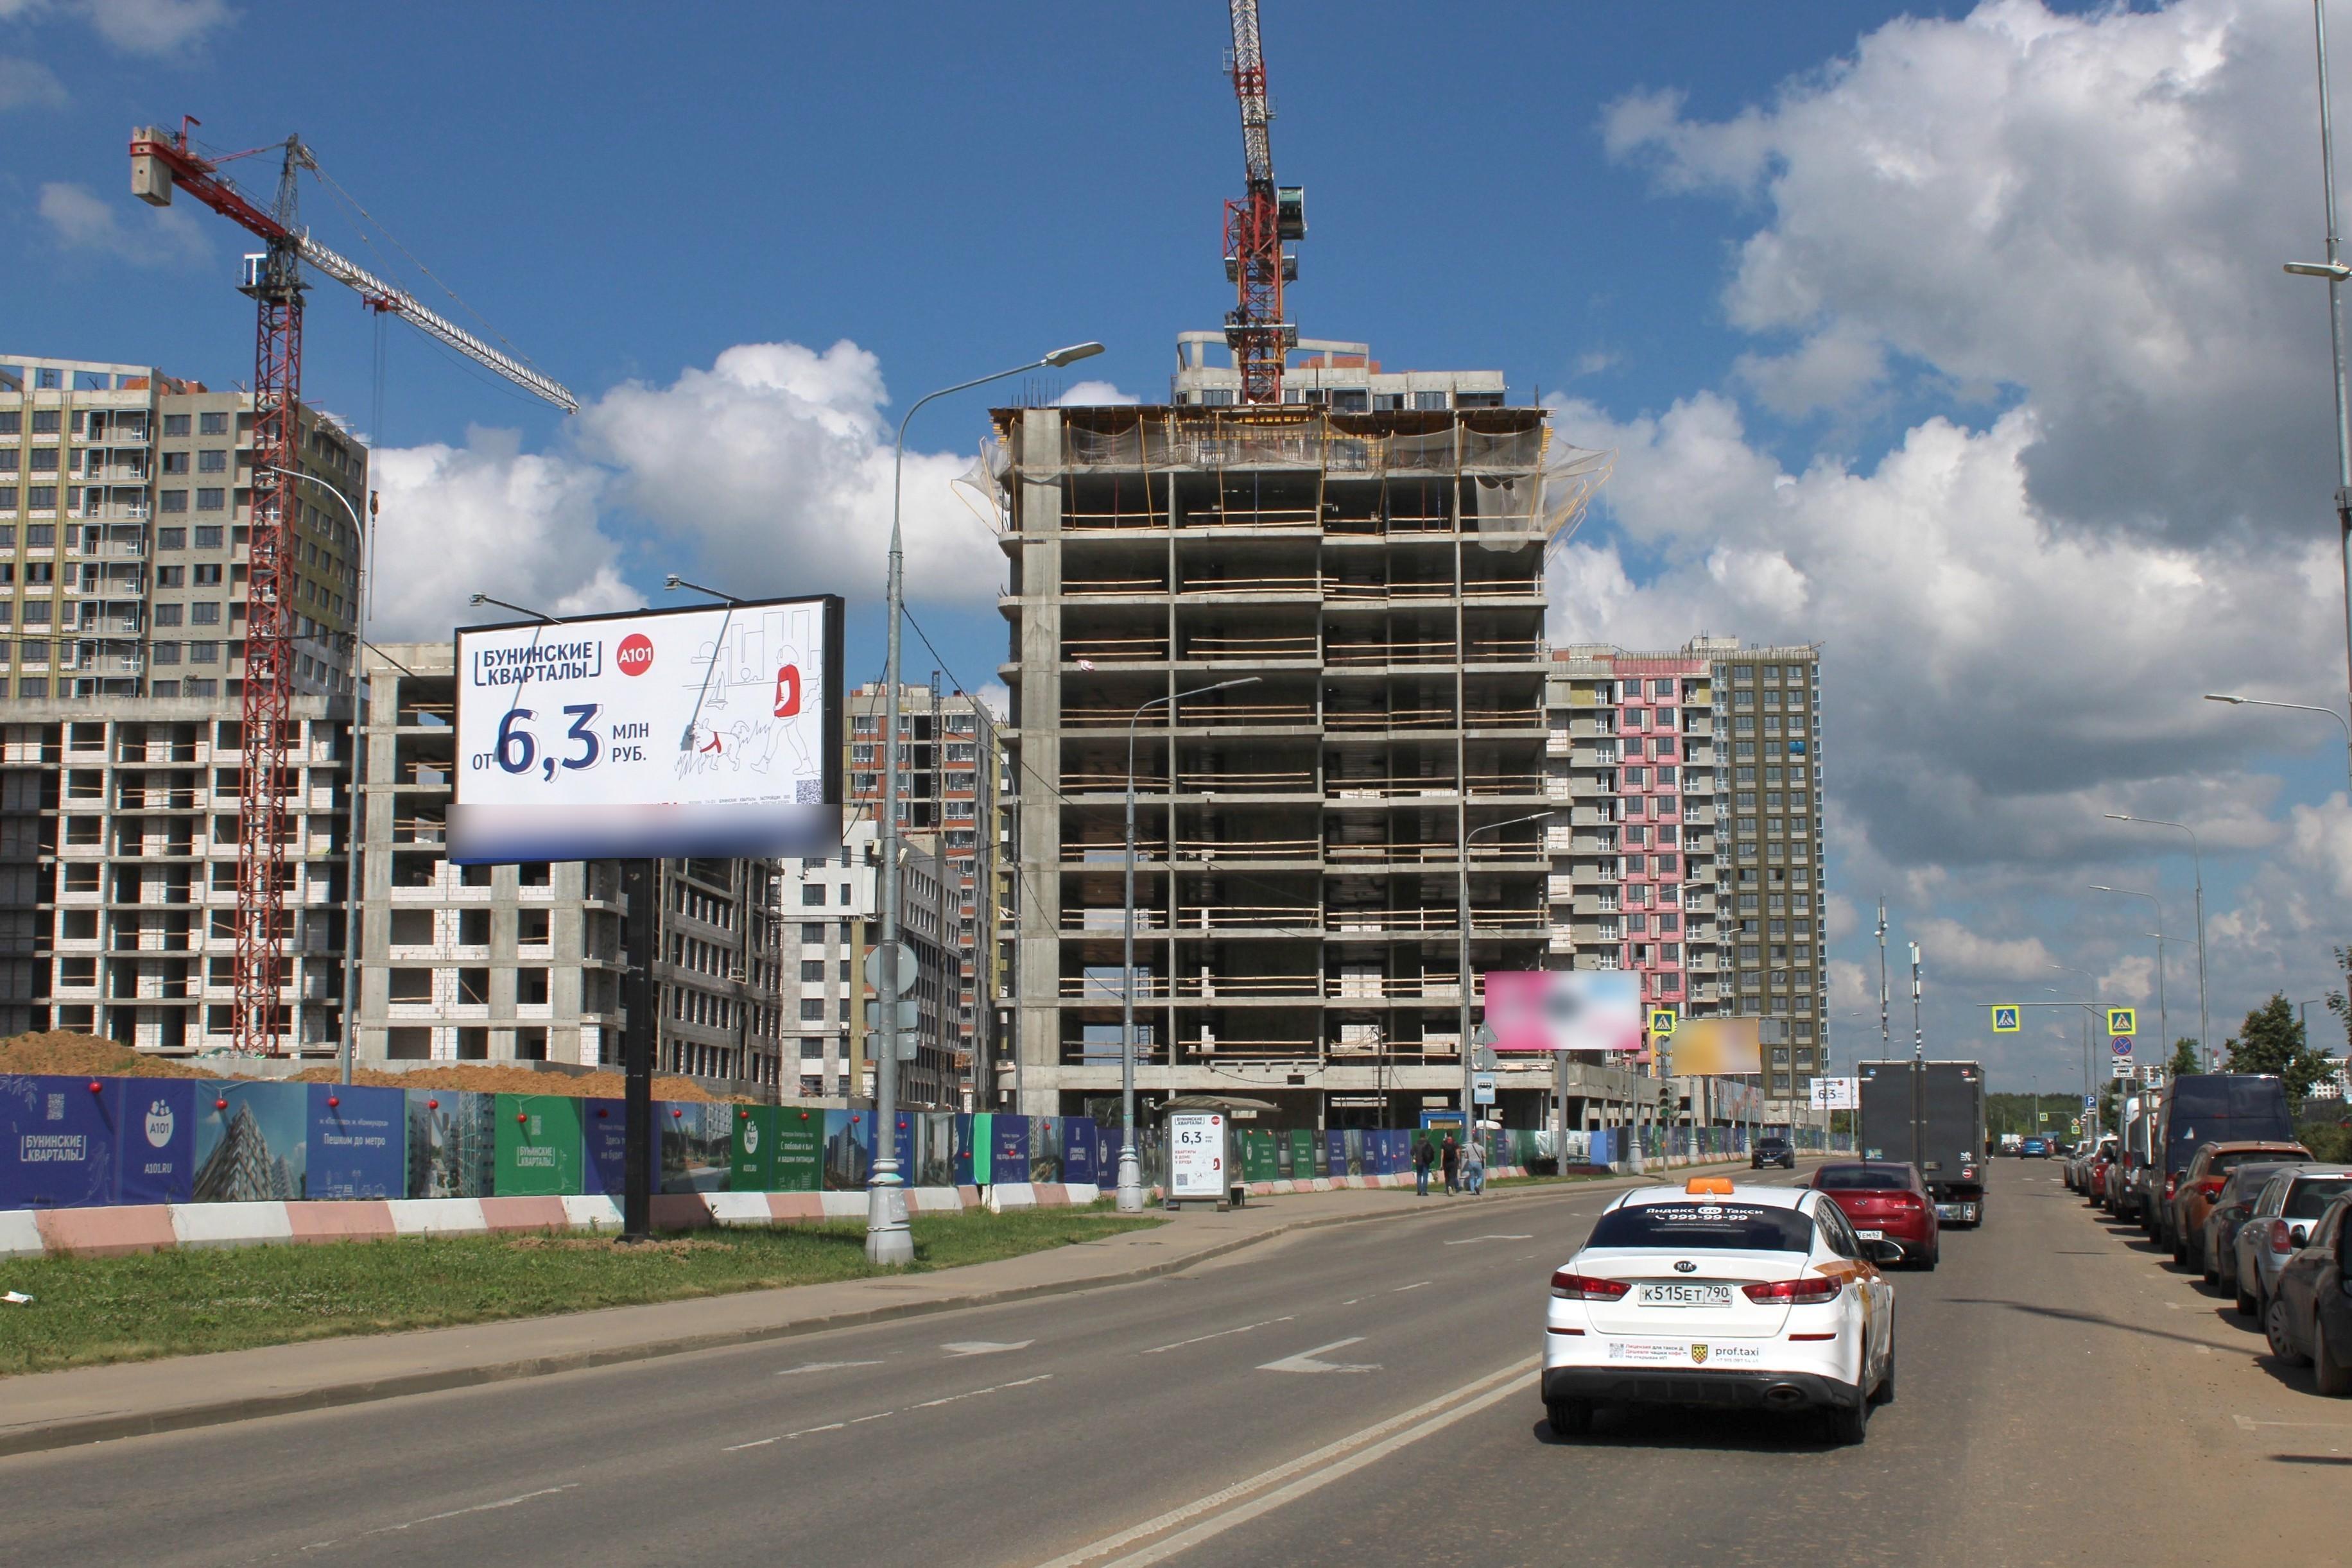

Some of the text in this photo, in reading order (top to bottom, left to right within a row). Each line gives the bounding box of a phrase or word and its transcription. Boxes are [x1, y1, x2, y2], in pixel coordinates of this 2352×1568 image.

[483, 642, 593, 668] БУНИНСКИЕ
[619, 647, 652, 664] А101
[488, 662, 588, 685] КВАРТАЛЫ
[498, 703, 601, 783] 6,3
[612, 724, 650, 740] МЛН
[612, 746, 646, 762] РУБ.
[150, 1123, 169, 1134] А101
[26, 1135, 82, 1148] БУНИНСКИЕ
[324, 1133, 386, 1148] Пешком до метро
[1182, 1131, 1202, 1145] 6,3
[28, 1149, 78, 1161] КВАРТАЛЫ
[144, 1163, 172, 1174] A101.RU
[1645, 1286, 1729, 1301] К515ЕТ 790
[1715, 1347, 1759, 1356] prof.taxi
